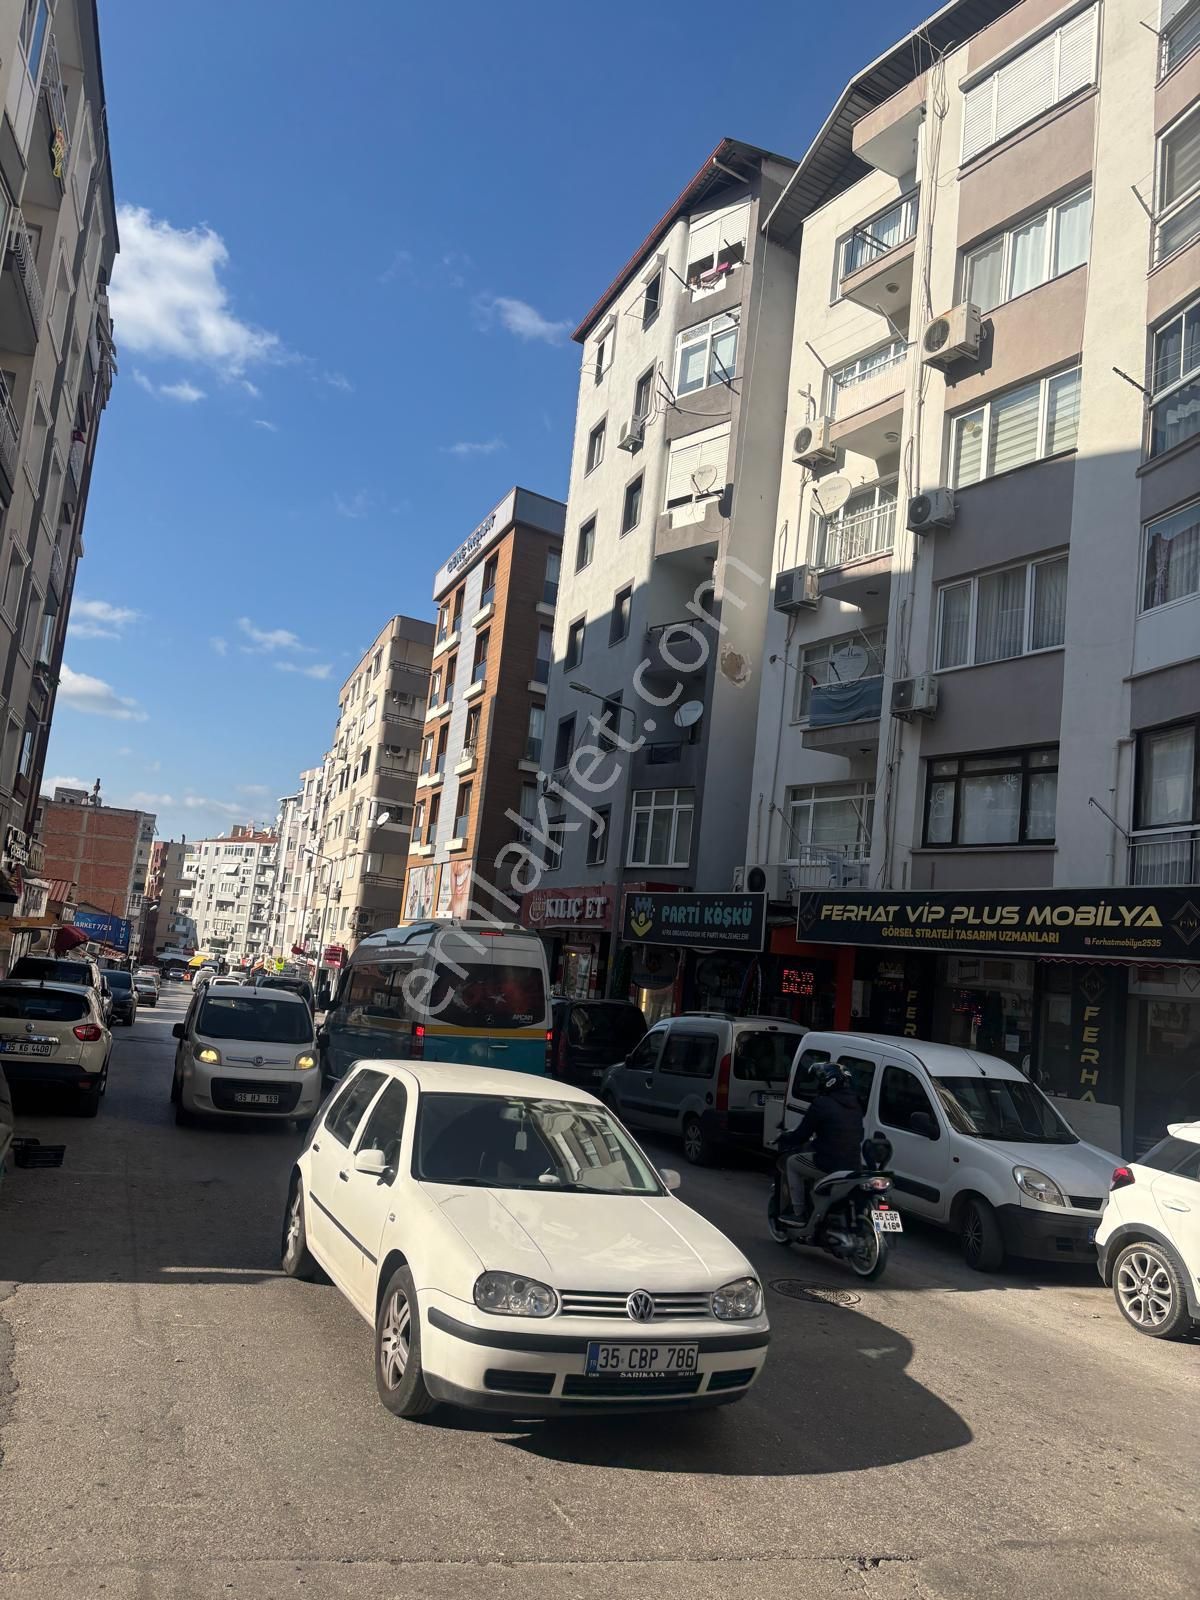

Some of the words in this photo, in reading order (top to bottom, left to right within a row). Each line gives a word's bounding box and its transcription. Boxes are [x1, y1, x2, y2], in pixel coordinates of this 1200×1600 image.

[545, 897, 583, 923] KILIÇ
[585, 896, 607, 918] ET
[661, 901, 700, 924] PARTİ
[704, 901, 752, 928] KÖŞKÜ
[821, 904, 900, 922] FERHAT
[906, 902, 945, 923] VİP
[951, 906, 1021, 925] PLUS
[1026, 900, 1163, 927] MOBİLYA
[881, 926, 914, 938] GÖRSEL
[915, 927, 955, 940] STRATEJİ
[956, 930, 997, 942] TASARIM
[999, 931, 1060, 944] UZMANLARI
[1091, 937, 1161, 949] Ferhatmobilya2535
[6, 1042, 16, 1051] 35
[238, 1093, 247, 1102] 35
[874, 1212, 884, 1221] 35
[600, 1348, 620, 1369] 35
[628, 1348, 658, 1369] CBP
[666, 1348, 695, 1369] 786
